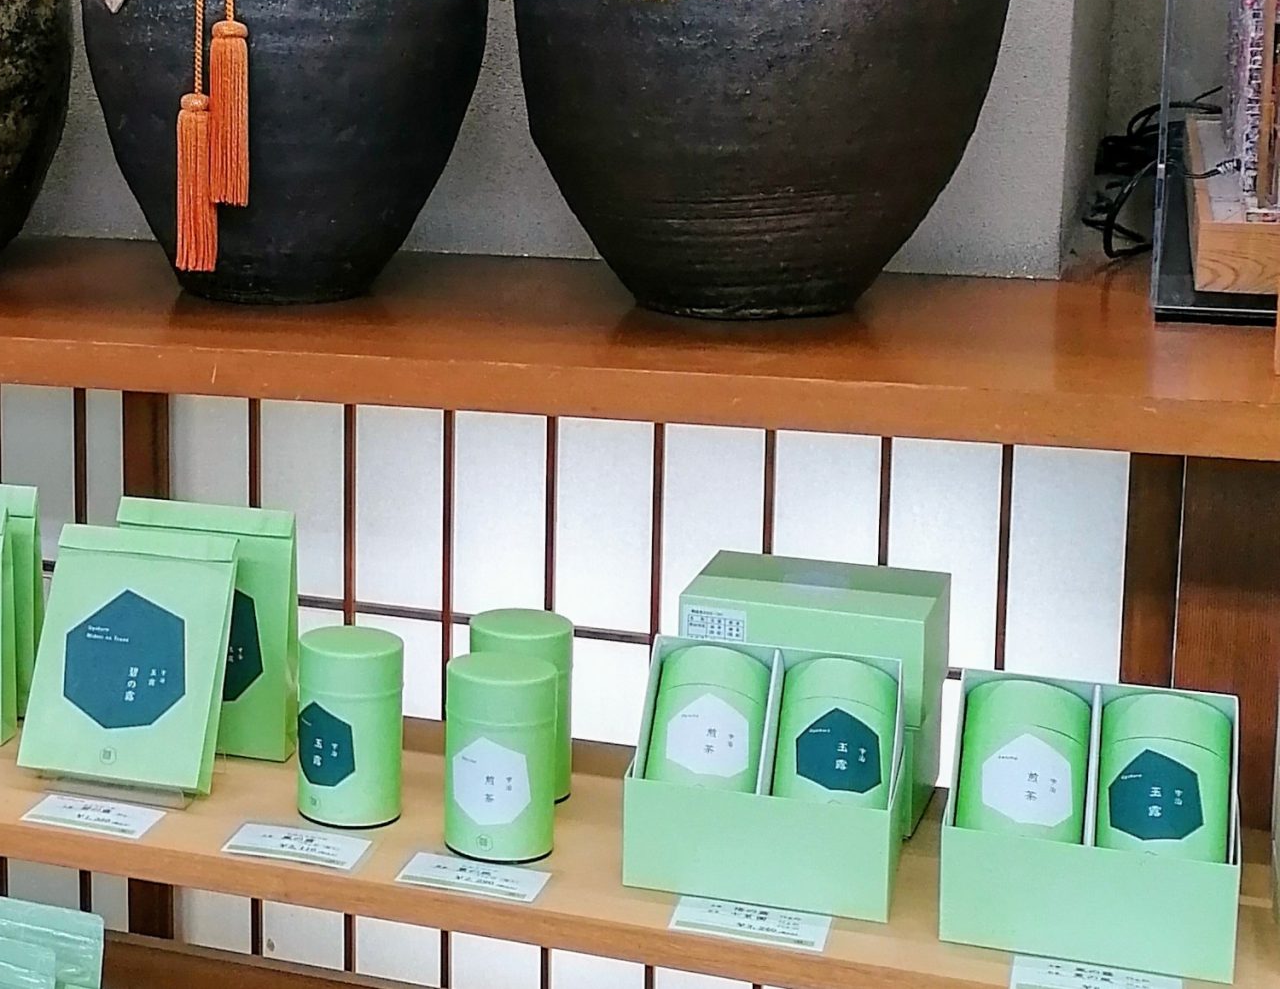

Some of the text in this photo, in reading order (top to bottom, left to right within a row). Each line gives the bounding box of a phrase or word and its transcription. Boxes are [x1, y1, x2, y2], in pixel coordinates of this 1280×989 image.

[834, 742, 849, 771] 玉露
[1024, 771, 1039, 802] 煎茶
[1147, 786, 1163, 818] 玉露
